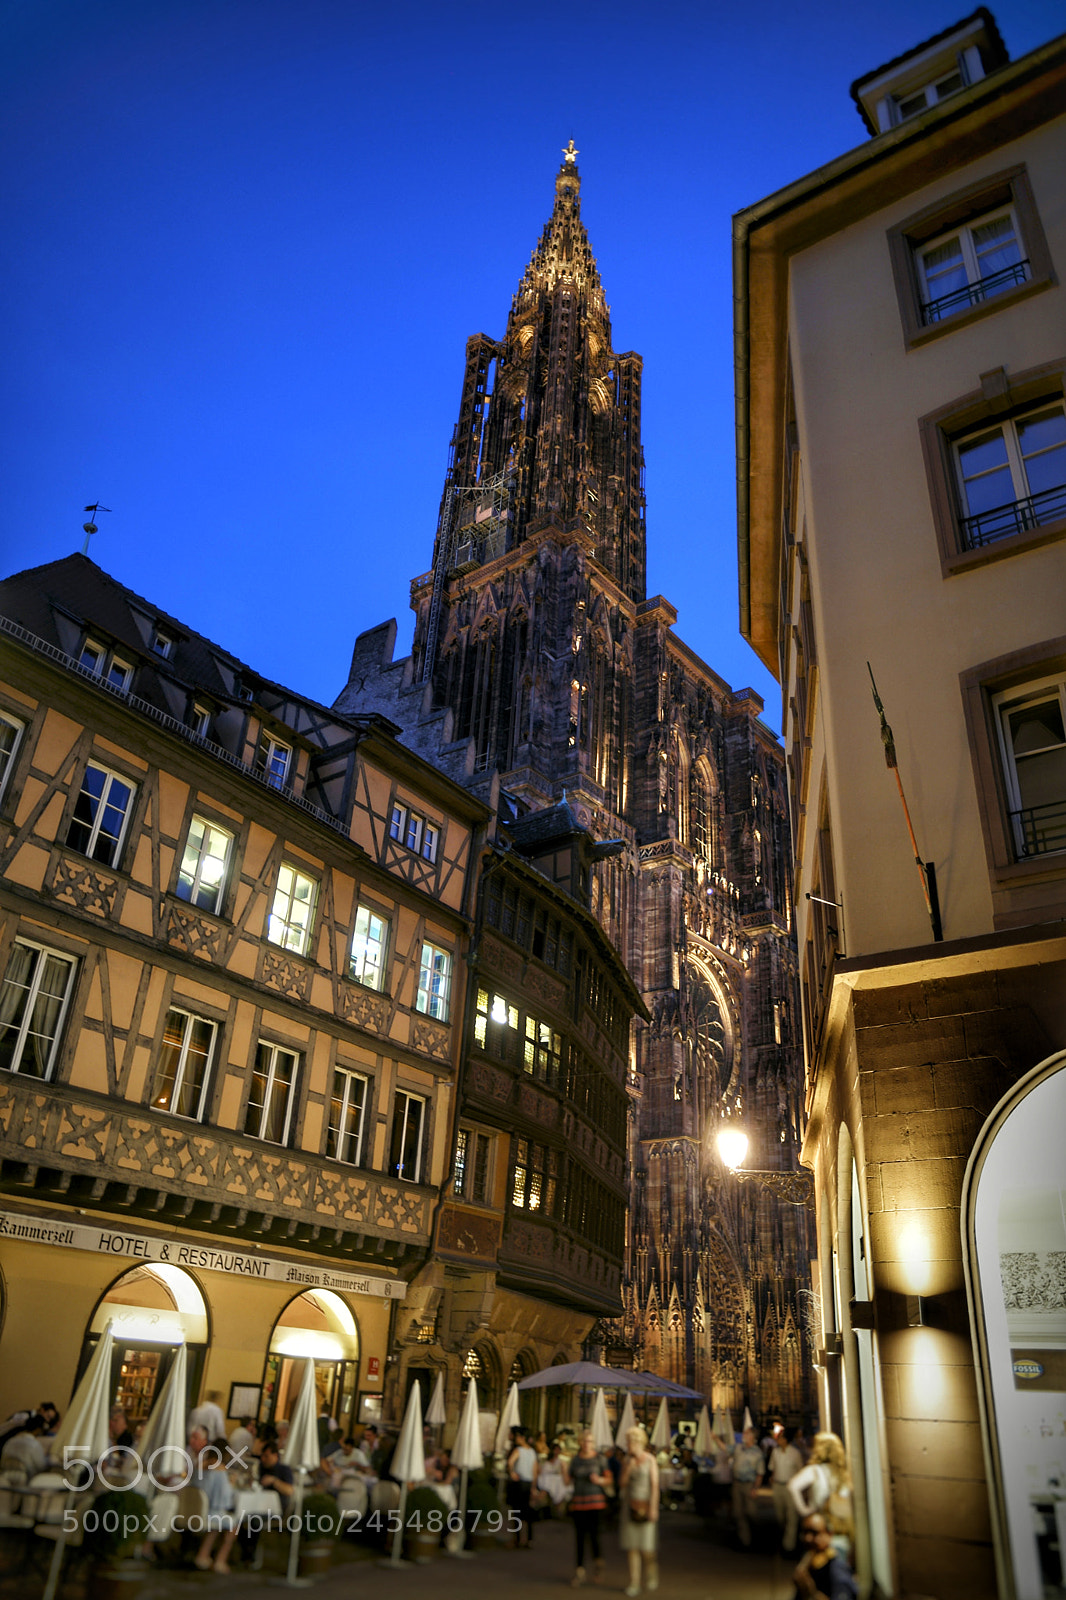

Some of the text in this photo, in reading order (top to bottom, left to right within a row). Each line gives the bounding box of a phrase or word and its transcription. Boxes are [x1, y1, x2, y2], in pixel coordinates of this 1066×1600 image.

[99, 1233, 151, 1258] HOTEL
[159, 1244, 170, 1261] &
[177, 1247, 271, 1277] RESTAURANT
[286, 1267, 320, 1284] Maison
[322, 1273, 370, 1292] Kammerzell
[1013, 1365, 1040, 1373] FOSSIL
